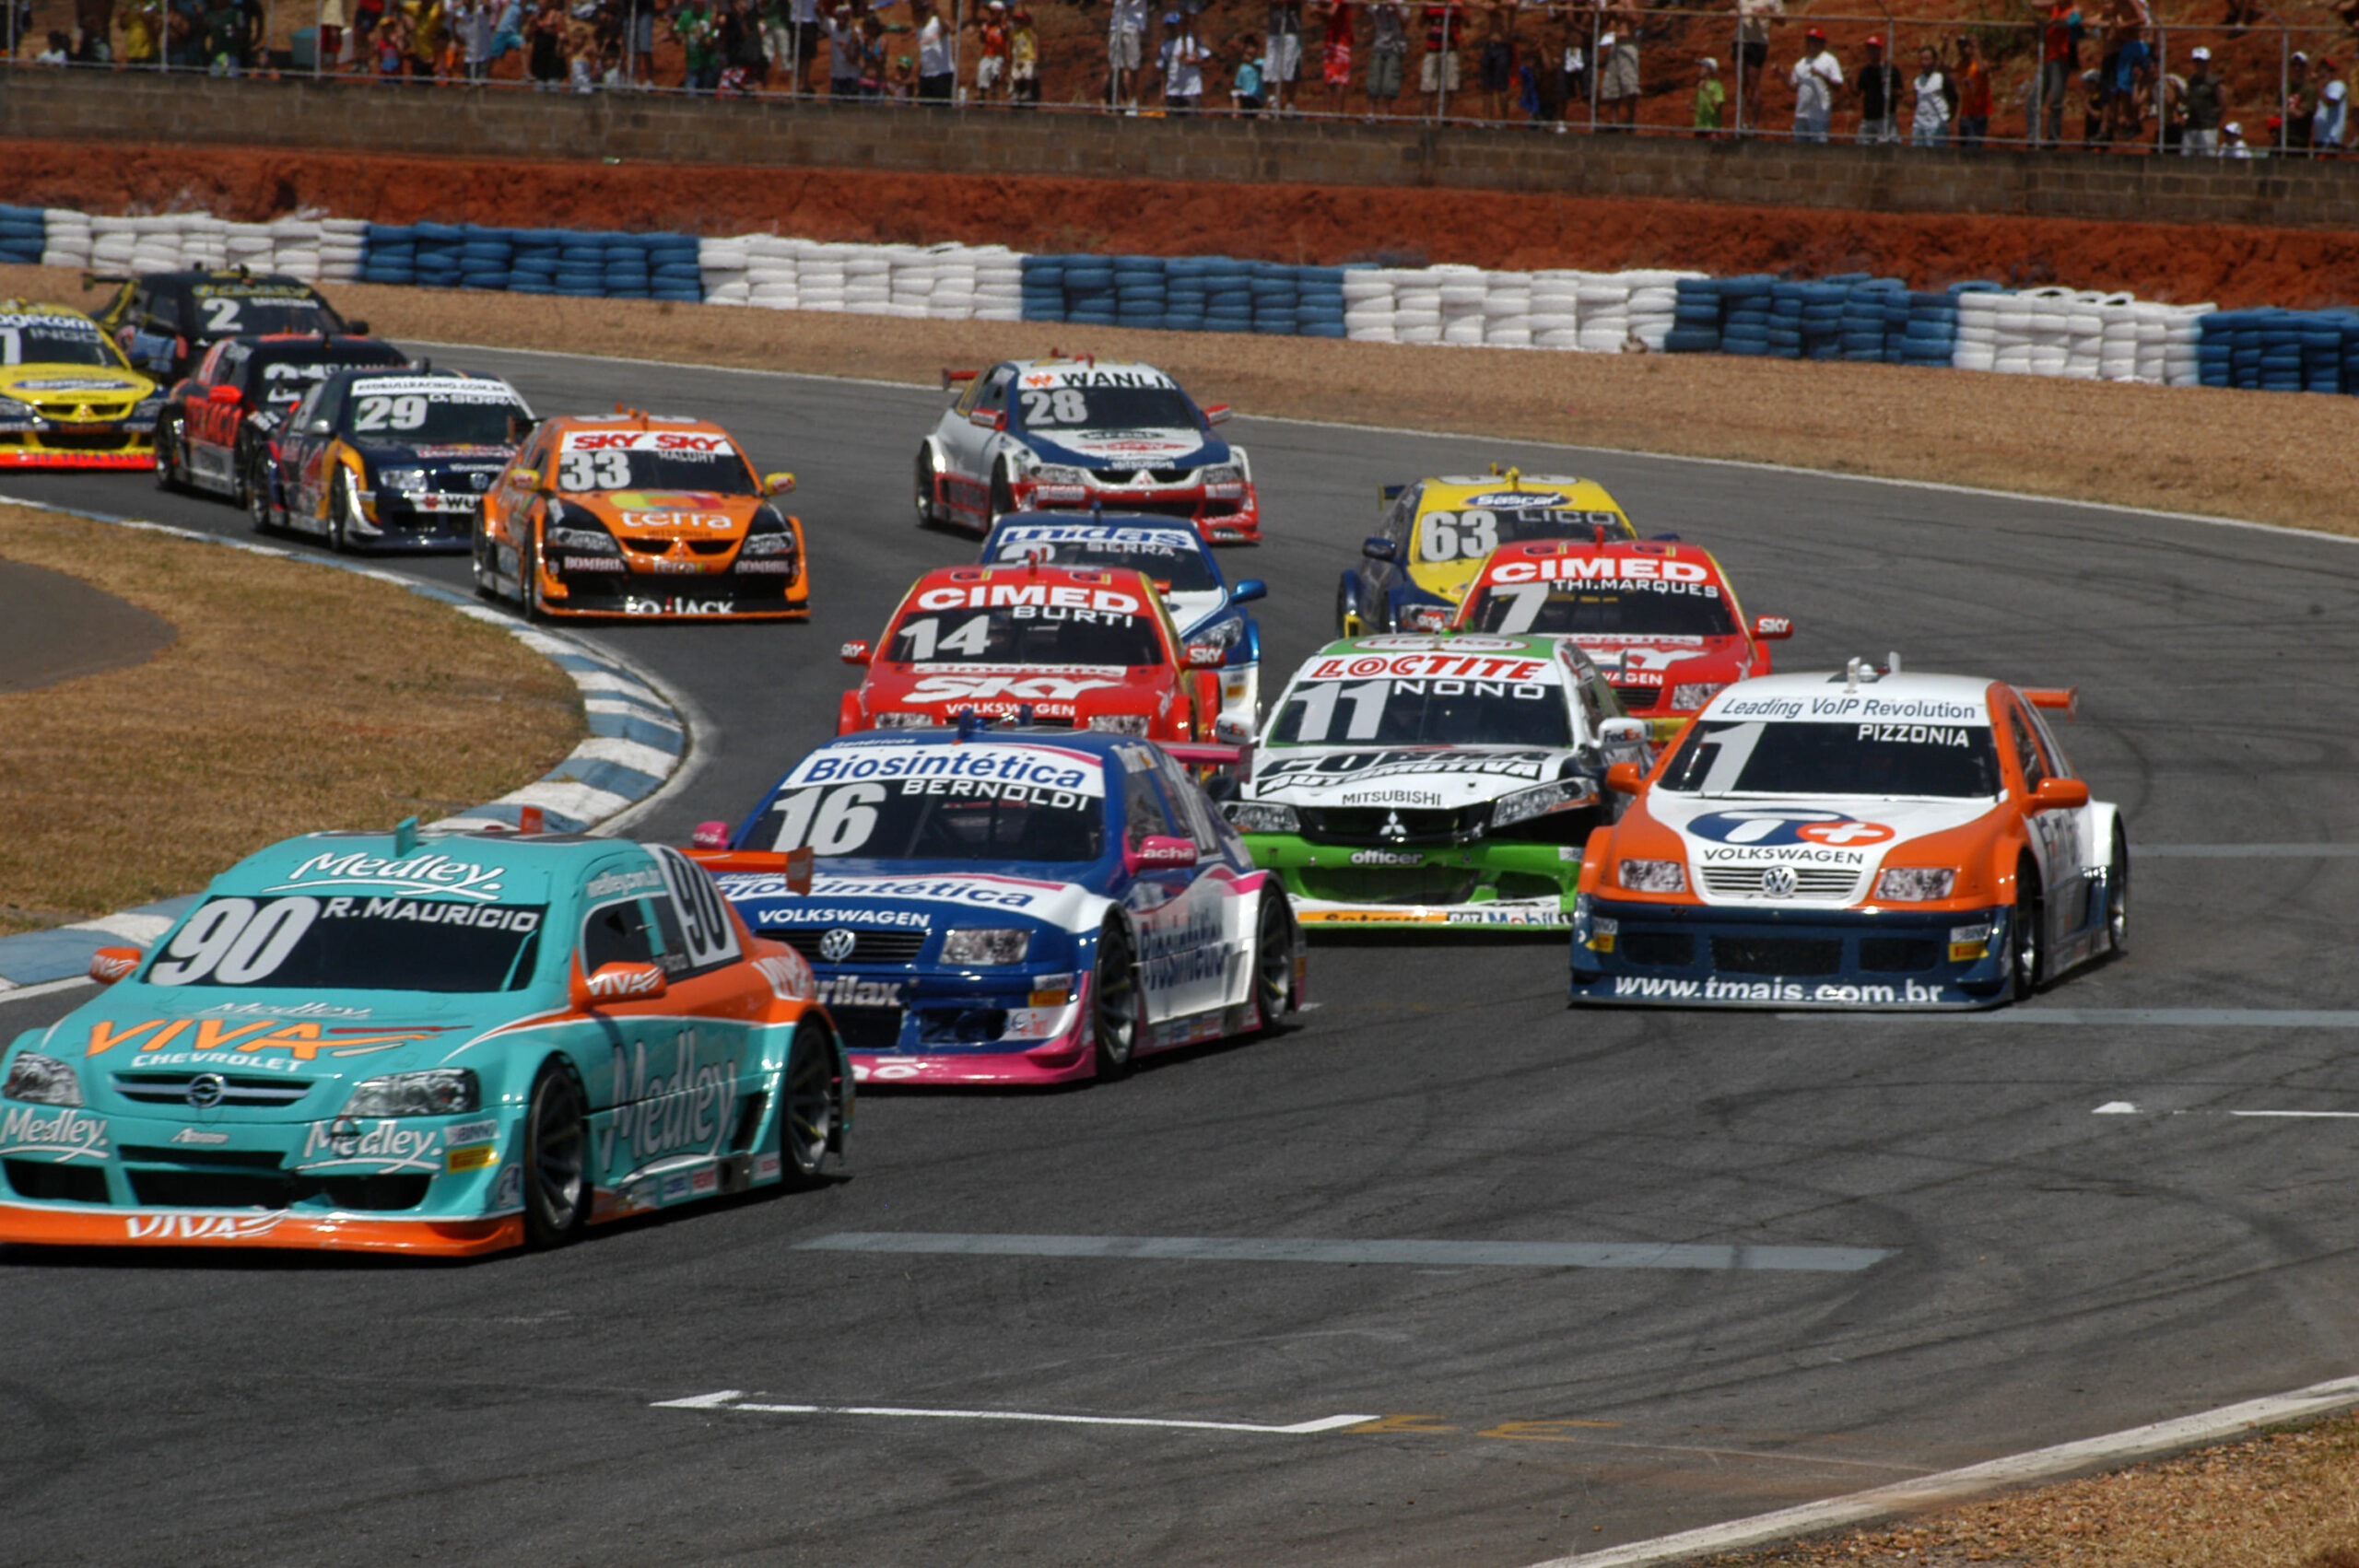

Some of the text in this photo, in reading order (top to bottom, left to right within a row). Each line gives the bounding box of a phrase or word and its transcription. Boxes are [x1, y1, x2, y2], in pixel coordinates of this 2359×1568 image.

[202, 298, 243, 332] 2
[1062, 371, 1165, 388] WANLI
[354, 395, 428, 431] 29
[1021, 389, 1088, 426] 28
[573, 433, 728, 451] SKY SKY
[558, 451, 632, 491] 33
[619, 510, 733, 529] terra
[1517, 509, 1615, 526] LICO
[1003, 526, 1191, 548] midas
[1420, 509, 1499, 562] 63
[1491, 557, 1708, 583] CIMED
[918, 584, 1140, 614] CIMED
[1490, 582, 1551, 635] 7
[1013, 605, 1133, 628] BURTI
[1757, 617, 1790, 634] SKY
[898, 614, 992, 661] 14
[1190, 647, 1223, 664] SKY
[1311, 655, 1548, 680] LOCTITE
[900, 675, 1124, 704] SKY
[945, 702, 1076, 718] VOLKSWGEN
[1290, 681, 1391, 743] 11
[1721, 696, 1977, 720] Leading VoIP Revolution
[1857, 723, 1970, 748] PIZZONIA
[802, 749, 1086, 790] Biosintética
[1699, 722, 1768, 793] 1
[900, 778, 1091, 813] BERNOLDI
[1342, 790, 1442, 807] MITSUBISHI
[771, 782, 887, 856] 16
[1350, 849, 1424, 866] officer
[1703, 848, 1866, 866] VOLKSWAGEN
[718, 878, 1035, 908] Biointética
[758, 907, 931, 928] VOLKSWAGEN
[149, 895, 322, 987] 90
[587, 971, 652, 997] VIVA
[1614, 975, 1944, 1004] www.tmais.com.br
[85, 1018, 324, 1061] VIVA
[130, 1051, 306, 1073] CHEVROLET
